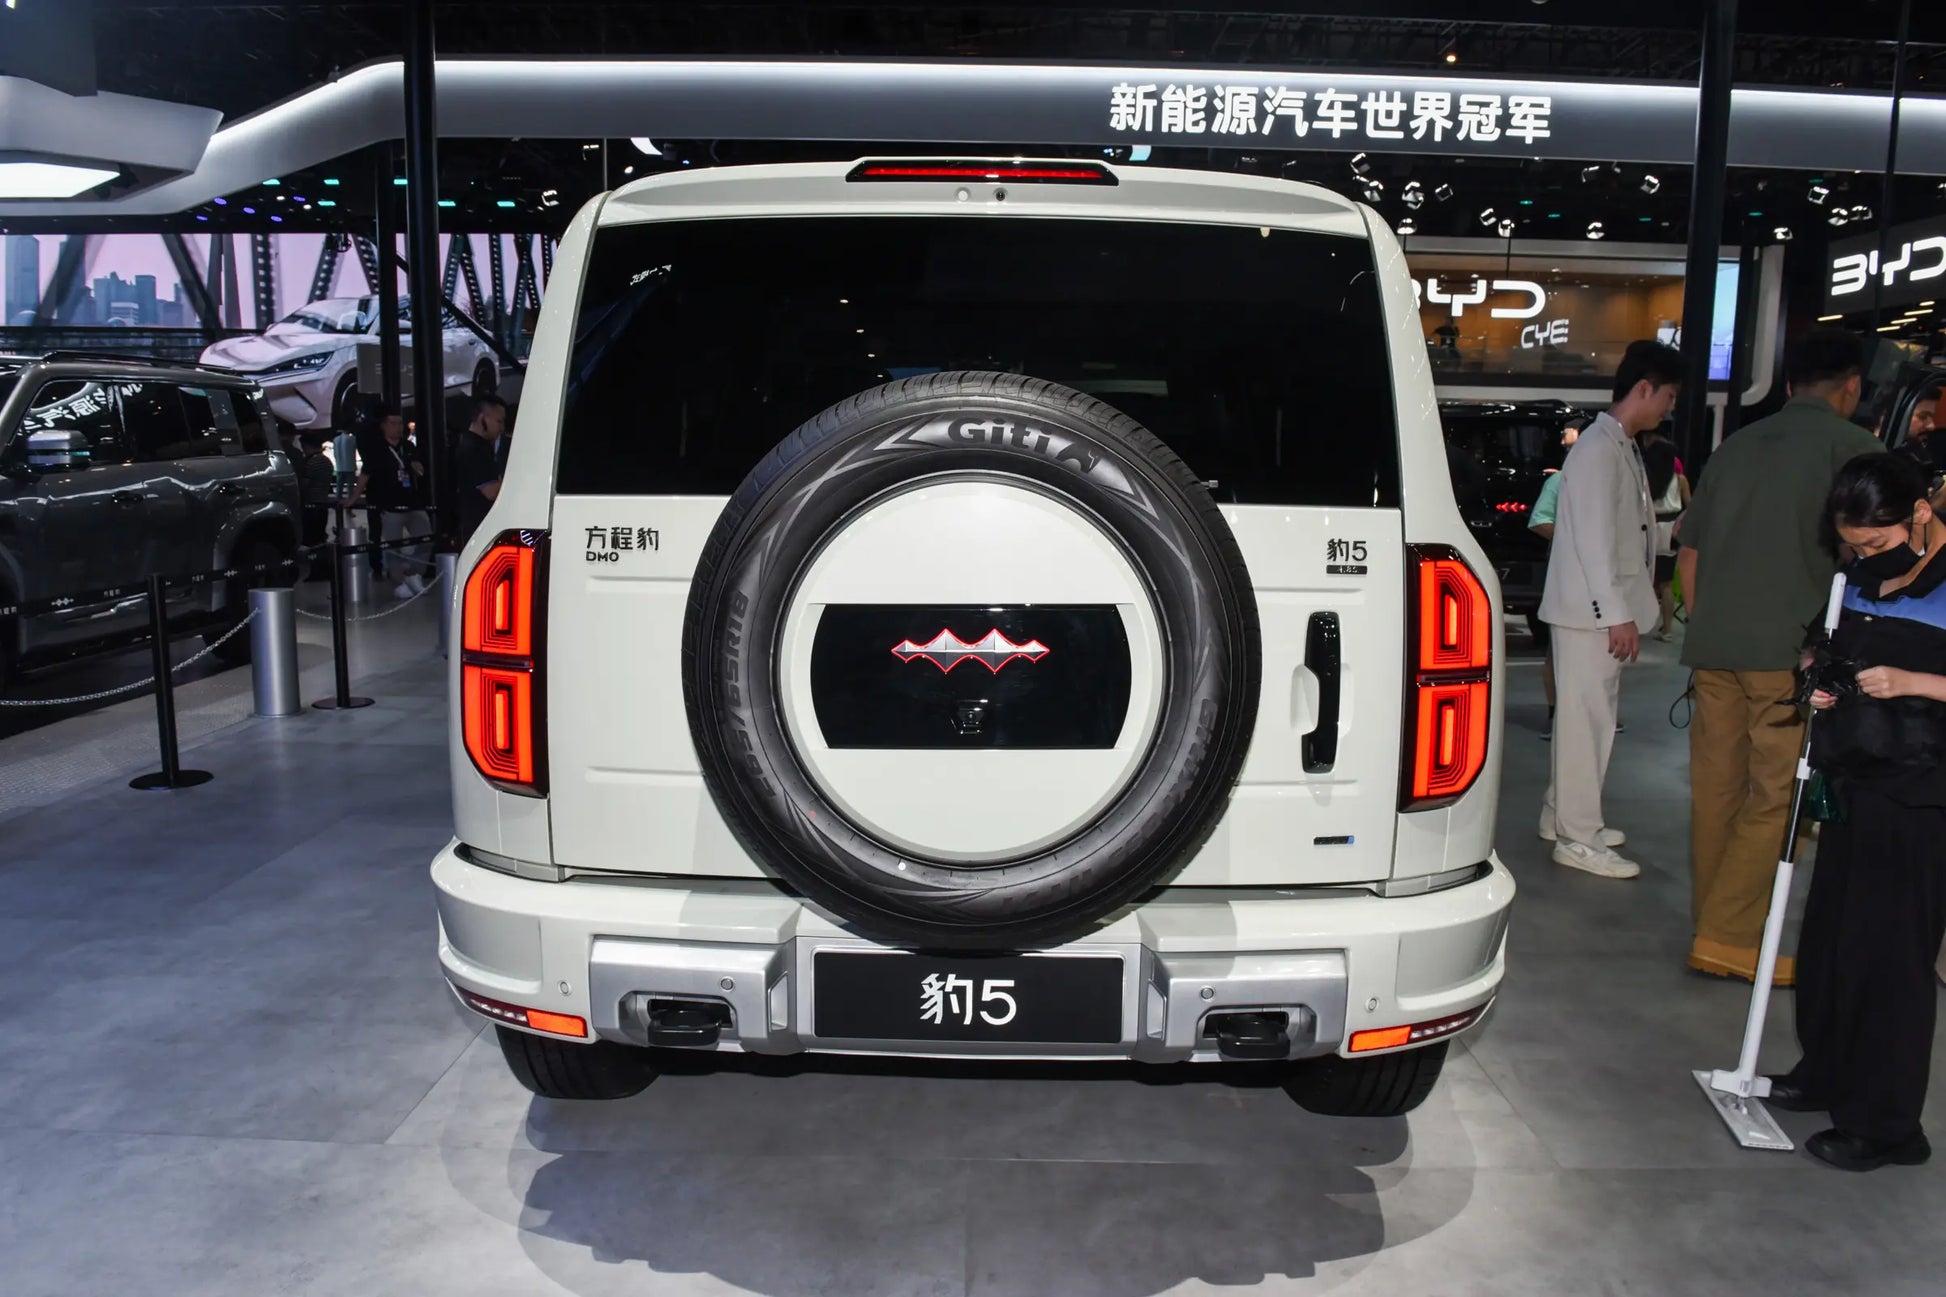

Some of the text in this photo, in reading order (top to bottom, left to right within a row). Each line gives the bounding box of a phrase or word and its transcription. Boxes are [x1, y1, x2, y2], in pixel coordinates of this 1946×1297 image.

[1109, 82, 1552, 144] 新能源汽车世界冠军
[1831, 236, 1946, 296] BYD
[584, 525, 660, 551] 方程豹
[585, 550, 620, 562] DMO
[1326, 538, 1368, 562] 豹5
[920, 973, 1017, 1026] 豹5
